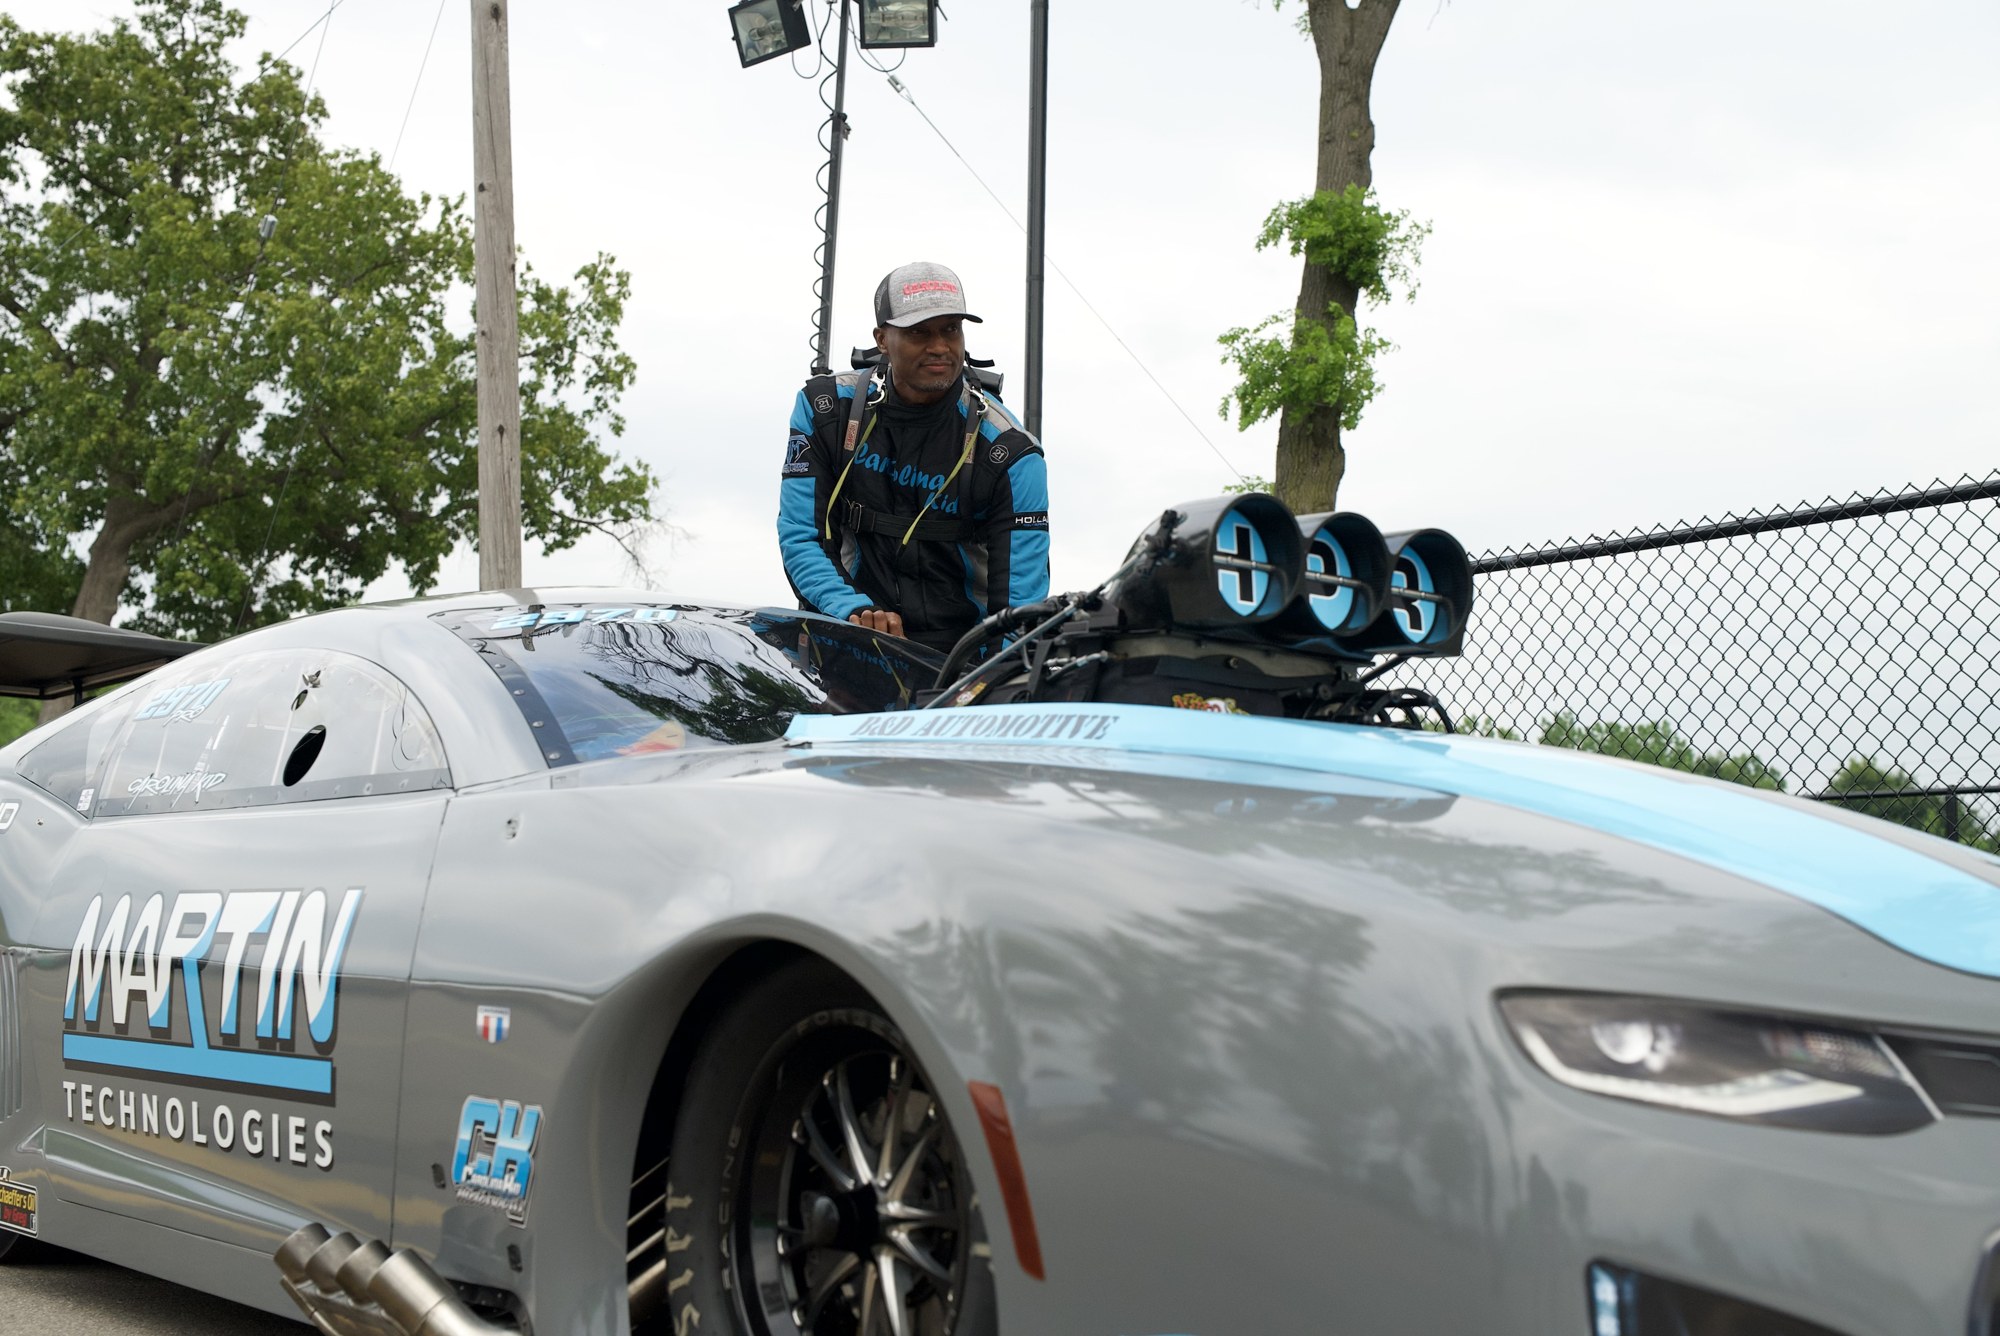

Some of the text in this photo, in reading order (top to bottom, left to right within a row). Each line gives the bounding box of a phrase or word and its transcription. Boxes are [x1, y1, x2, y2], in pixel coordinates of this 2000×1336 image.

[922, 492, 960, 515] Kid
[490, 608, 678, 630] 2970
[134, 678, 232, 721] 2970
[163, 704, 206, 728] PRO
[910, 714, 1120, 740] AUTOMOTIVE
[190, 771, 228, 803] KID
[63, 888, 365, 1049] MARTIN
[62, 1080, 334, 1168] TECHNOLOGIES
